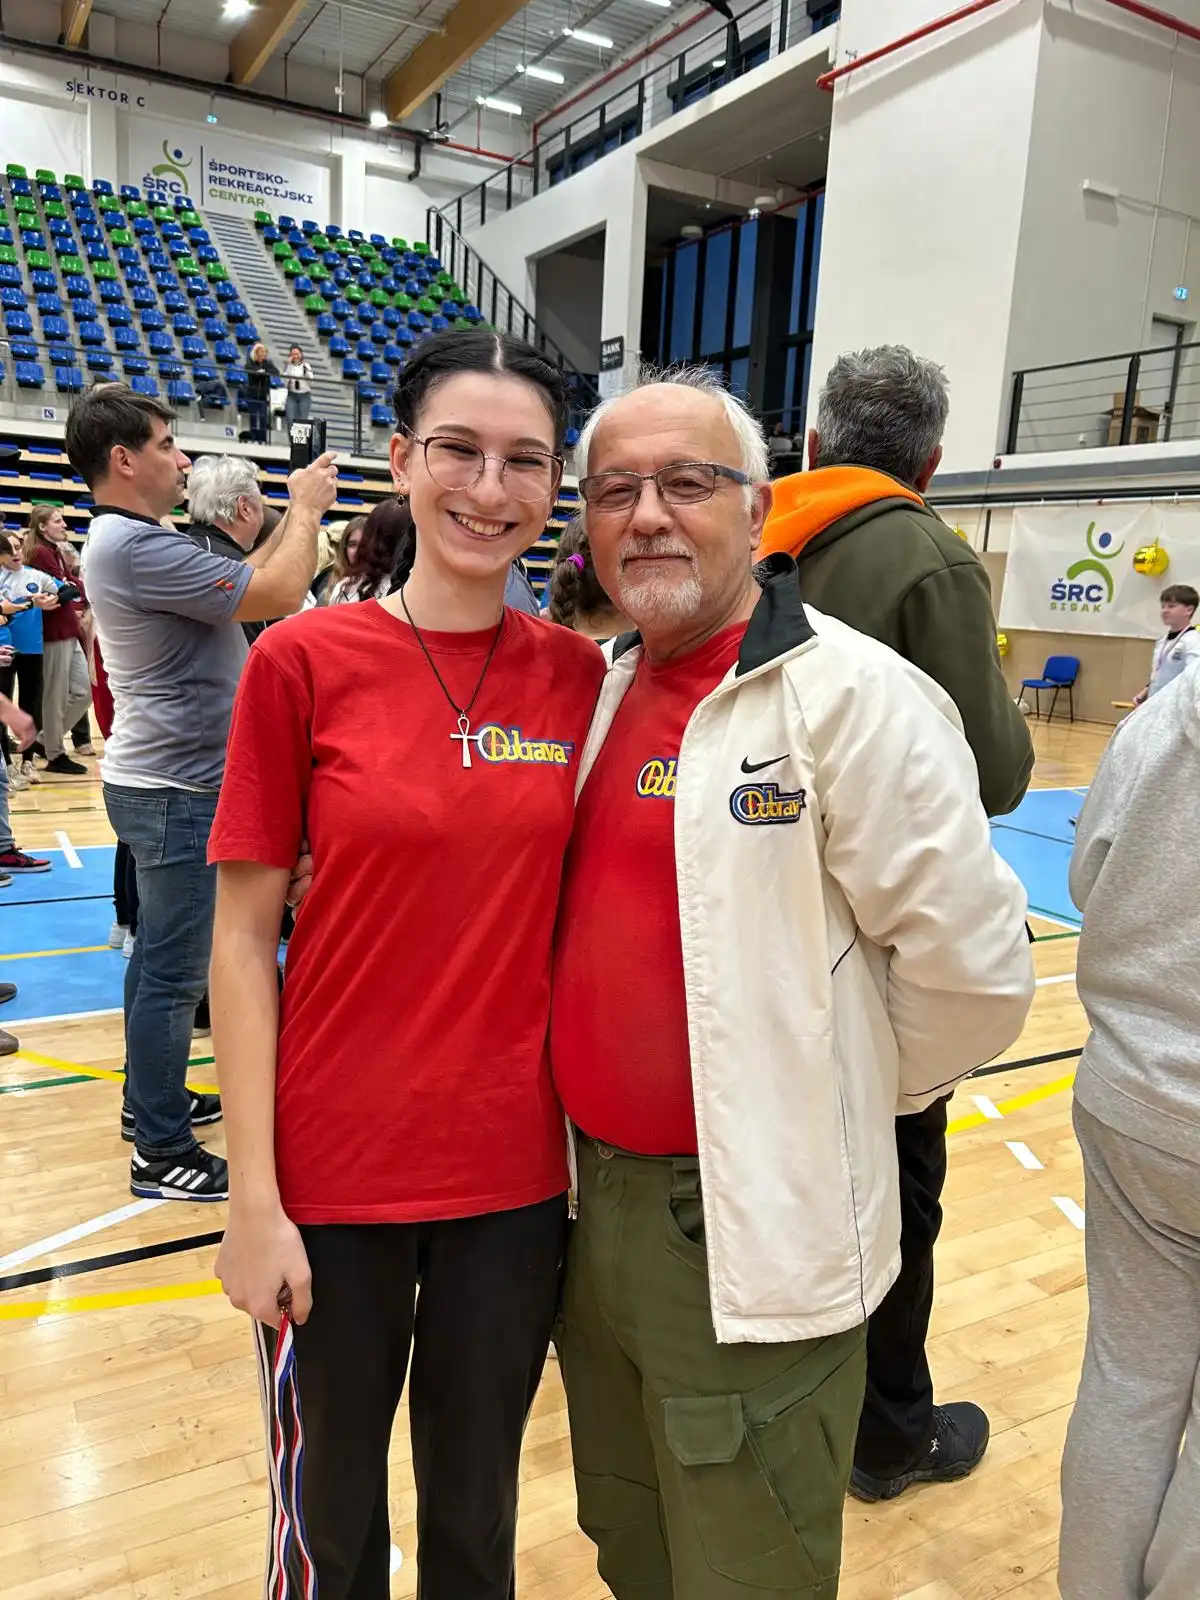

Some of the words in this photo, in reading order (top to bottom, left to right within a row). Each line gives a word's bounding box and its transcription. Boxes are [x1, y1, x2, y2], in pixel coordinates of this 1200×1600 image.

[66, 80, 128, 104] SEKTOR
[136, 96, 145, 107] C
[142, 173, 182, 194] ŠRC
[208, 158, 289, 185] ŠPORTSKO-
[208, 174, 314, 204] REKREACIJSKI
[208, 188, 265, 207] CENTAR
[1051, 577, 1103, 602] ŠRC
[1050, 601, 1102, 612] SISAK
[477, 726, 569, 764] Dubrava
[737, 790, 801, 819] Dubrav
